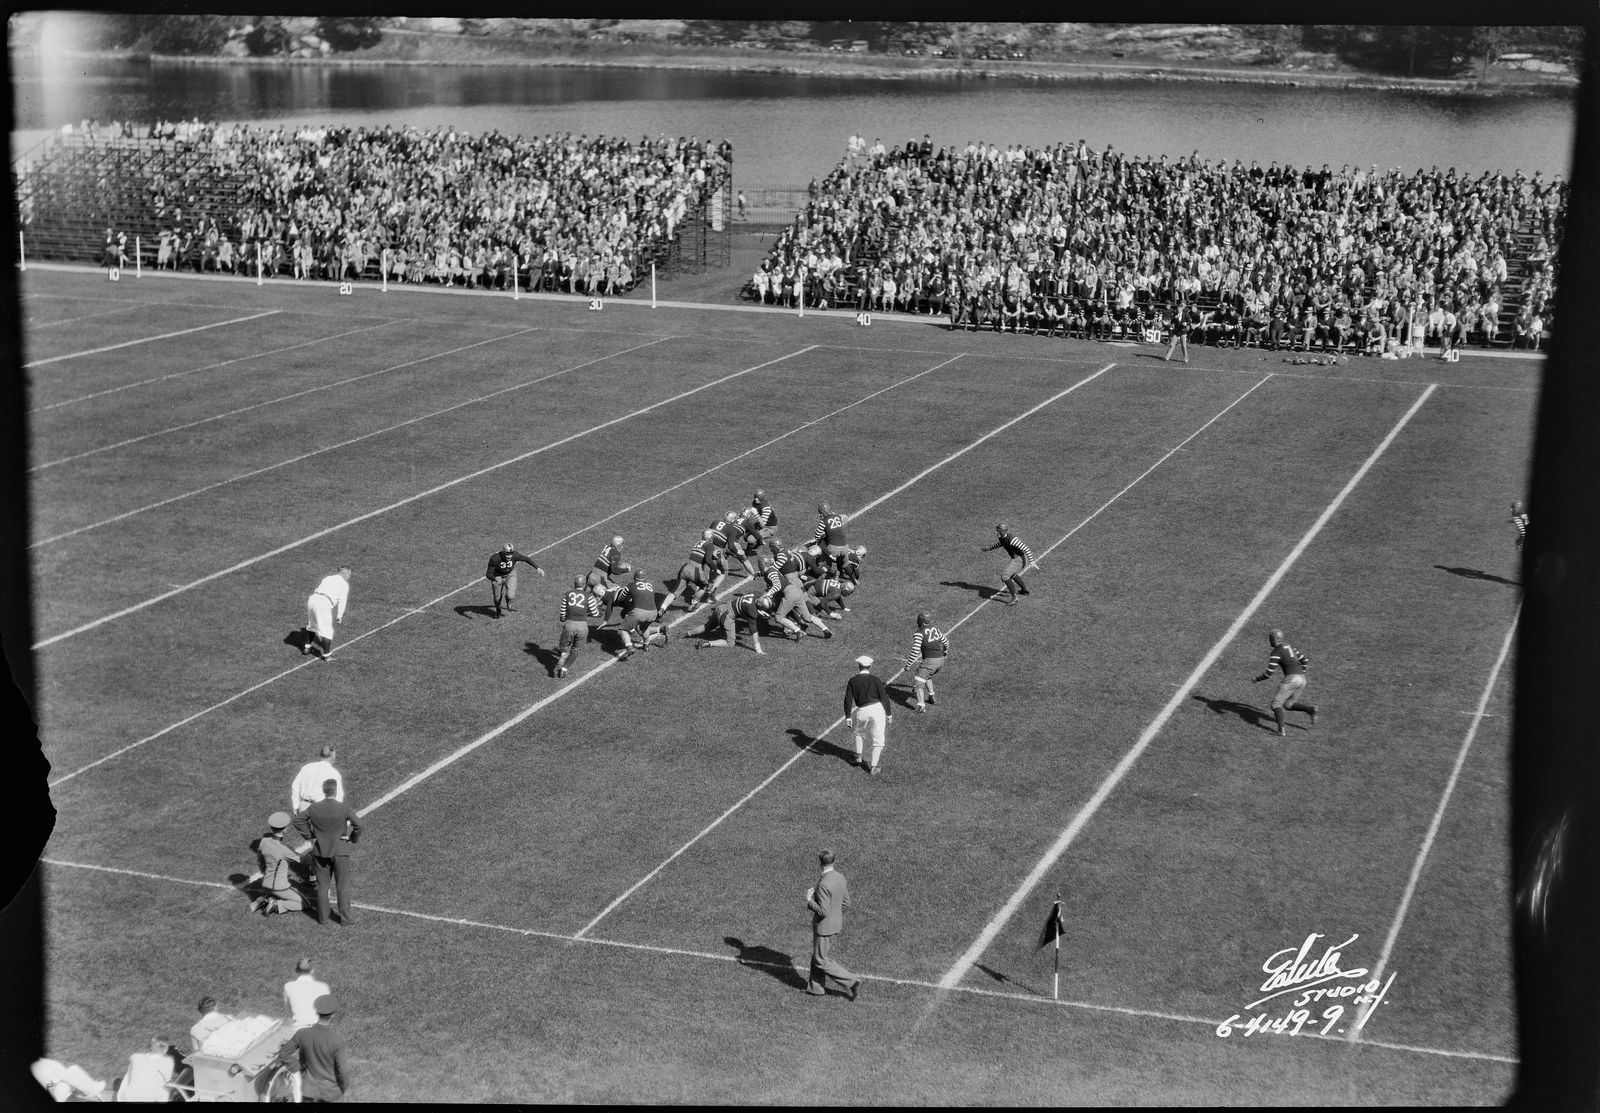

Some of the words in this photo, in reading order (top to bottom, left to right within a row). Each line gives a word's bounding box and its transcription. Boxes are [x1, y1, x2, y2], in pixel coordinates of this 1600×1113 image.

[109, 268, 120, 281] 10
[339, 281, 352, 295] 20
[589, 297, 603, 310] 30
[856, 313, 871, 326] 40
[1145, 329, 1161, 343] 50
[1441, 349, 1459, 362] 40
[715, 521, 726, 531] 8
[827, 516, 842, 529] 26
[500, 560, 513, 569] 33
[635, 581, 654, 592] 36
[568, 591, 585, 608] 32
[924, 627, 940, 642] 23
